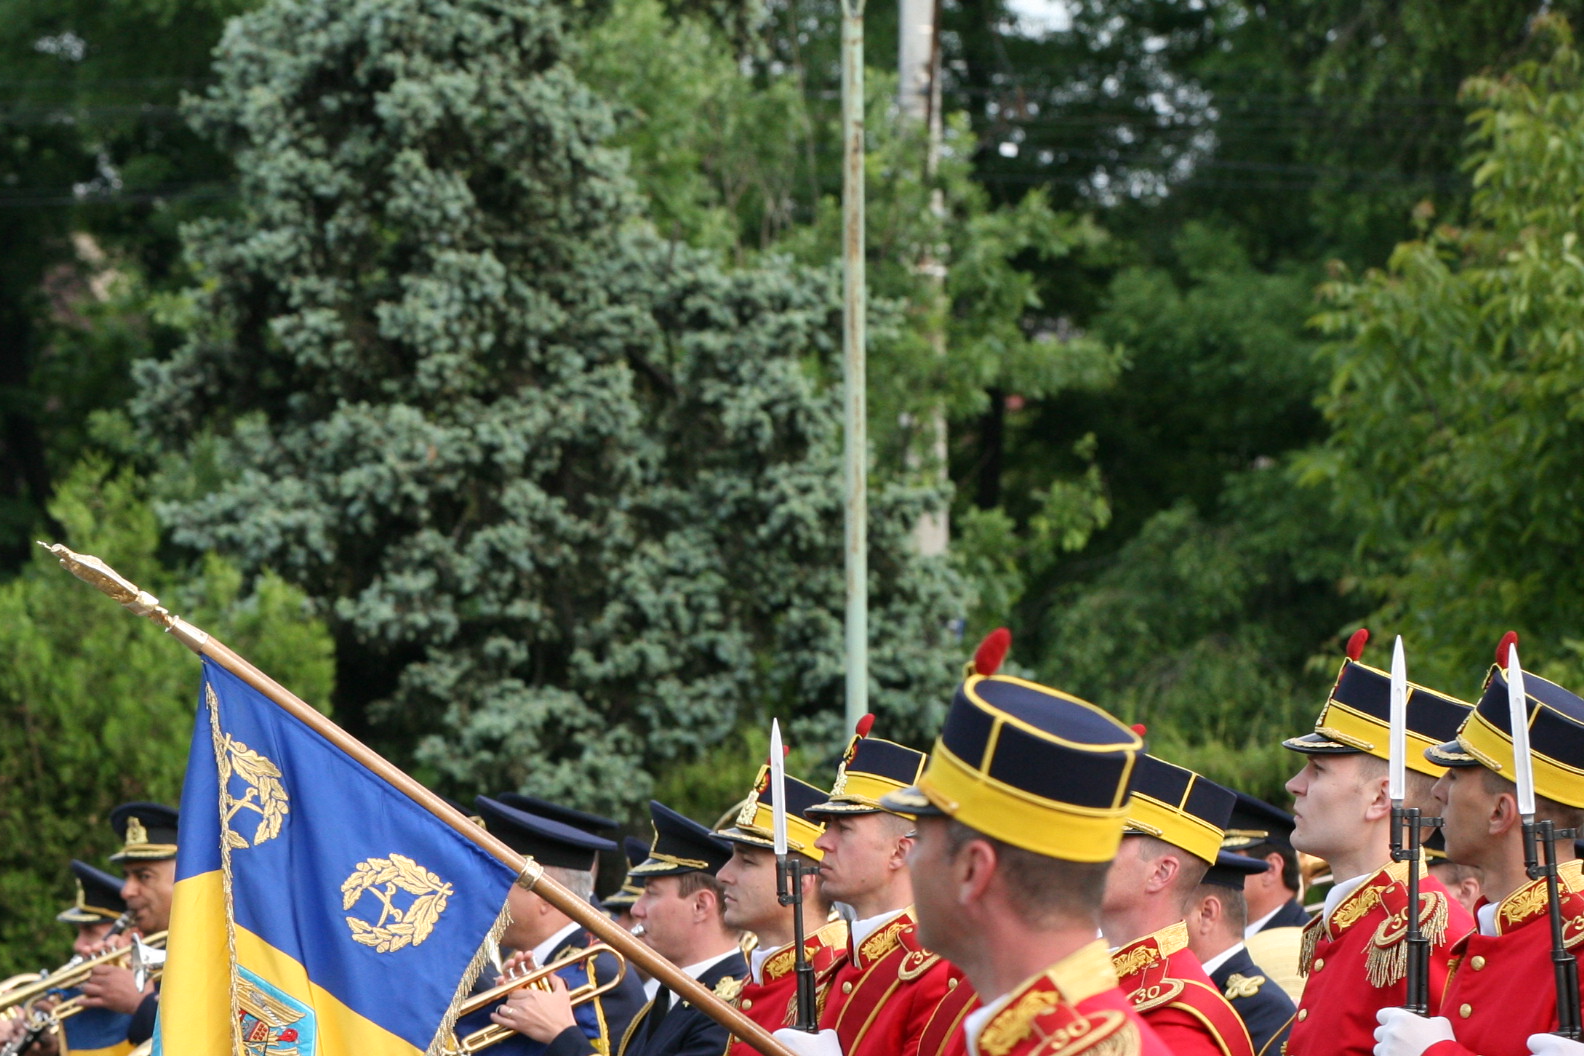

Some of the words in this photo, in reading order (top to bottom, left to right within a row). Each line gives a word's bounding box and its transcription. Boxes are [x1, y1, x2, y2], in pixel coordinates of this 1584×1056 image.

[1572, 915, 1584, 930] 3
[1135, 985, 1161, 1004] 30
[1051, 1018, 1091, 1050] 30
